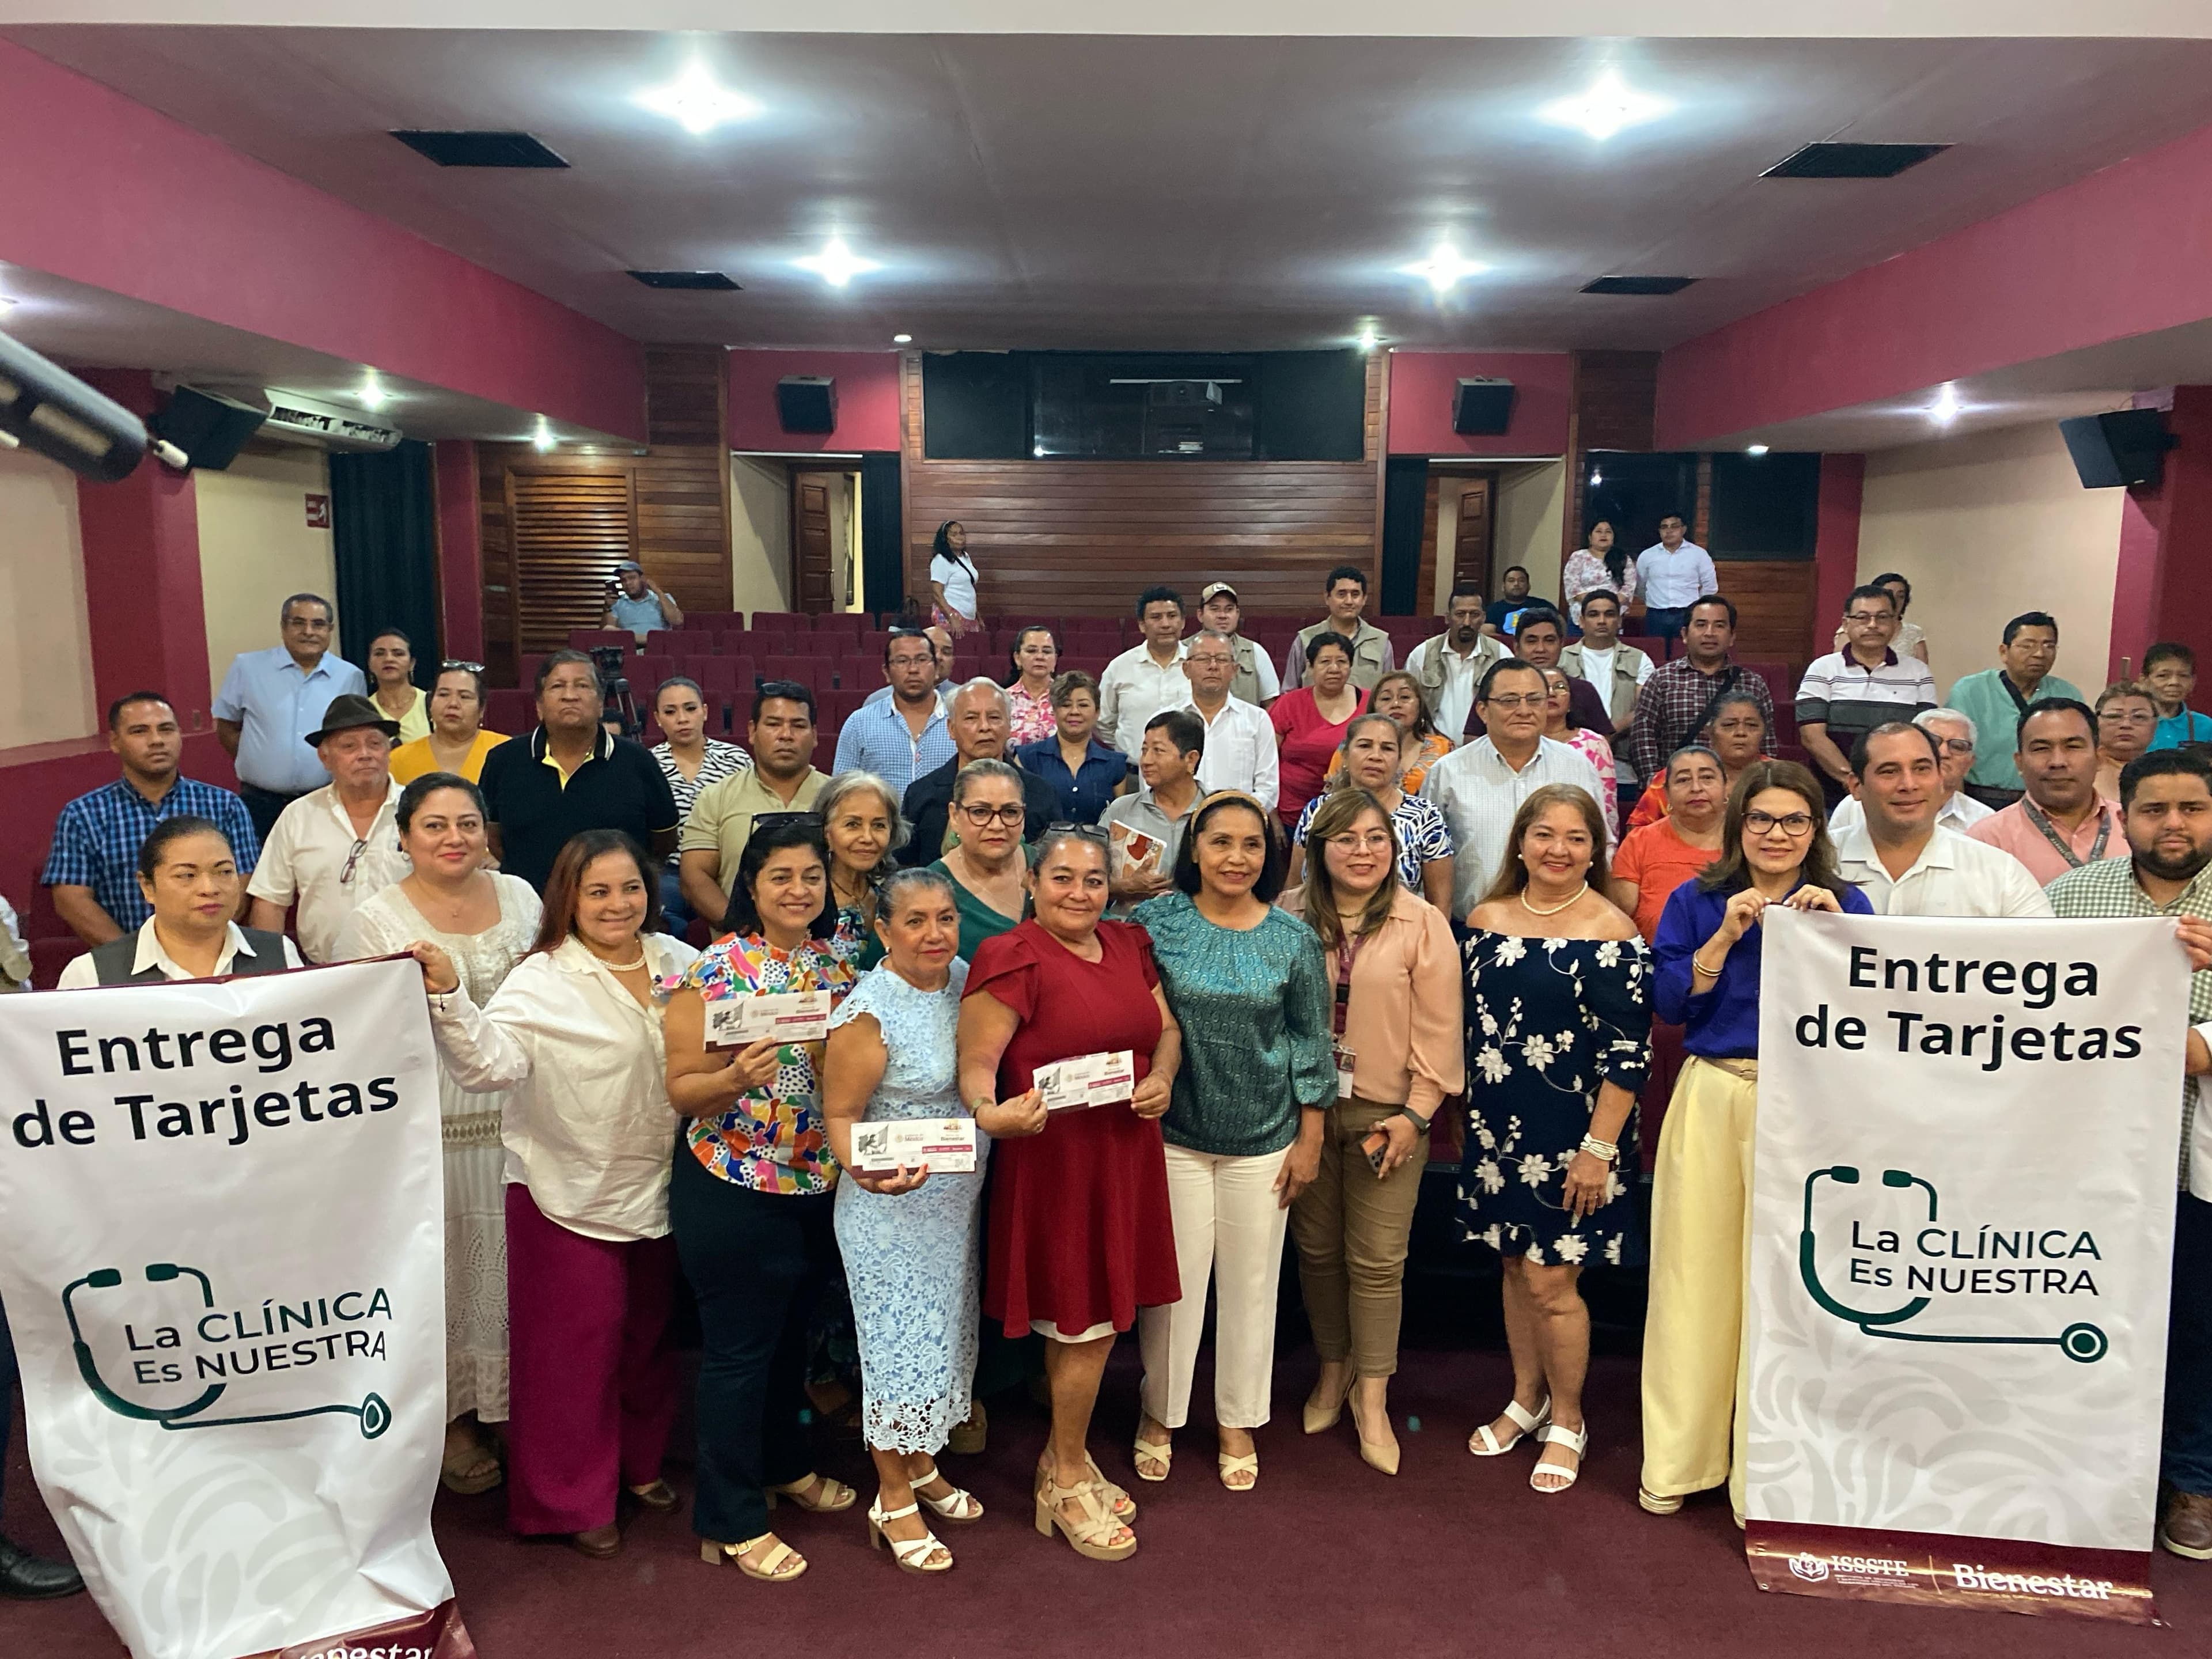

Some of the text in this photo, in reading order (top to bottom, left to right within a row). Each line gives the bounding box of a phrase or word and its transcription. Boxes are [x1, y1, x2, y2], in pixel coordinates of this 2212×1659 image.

[1850, 945, 2097, 1009] Entrega
[56, 1017, 335, 1076] Entrega
[1796, 1004, 2142, 1071] de Tarjetas
[13, 1077, 399, 1148] de Tarjetas
[1852, 1220, 2102, 1260] La CLÍNICA
[1850, 1257, 2099, 1296] Es NUESTRA
[124, 1287, 392, 1351] La CLÍNICA
[133, 1330, 386, 1384] Es NUESTRA
[1831, 1555, 1910, 1577] ISSSTE
[1953, 1563, 2113, 1600] Bienestar
